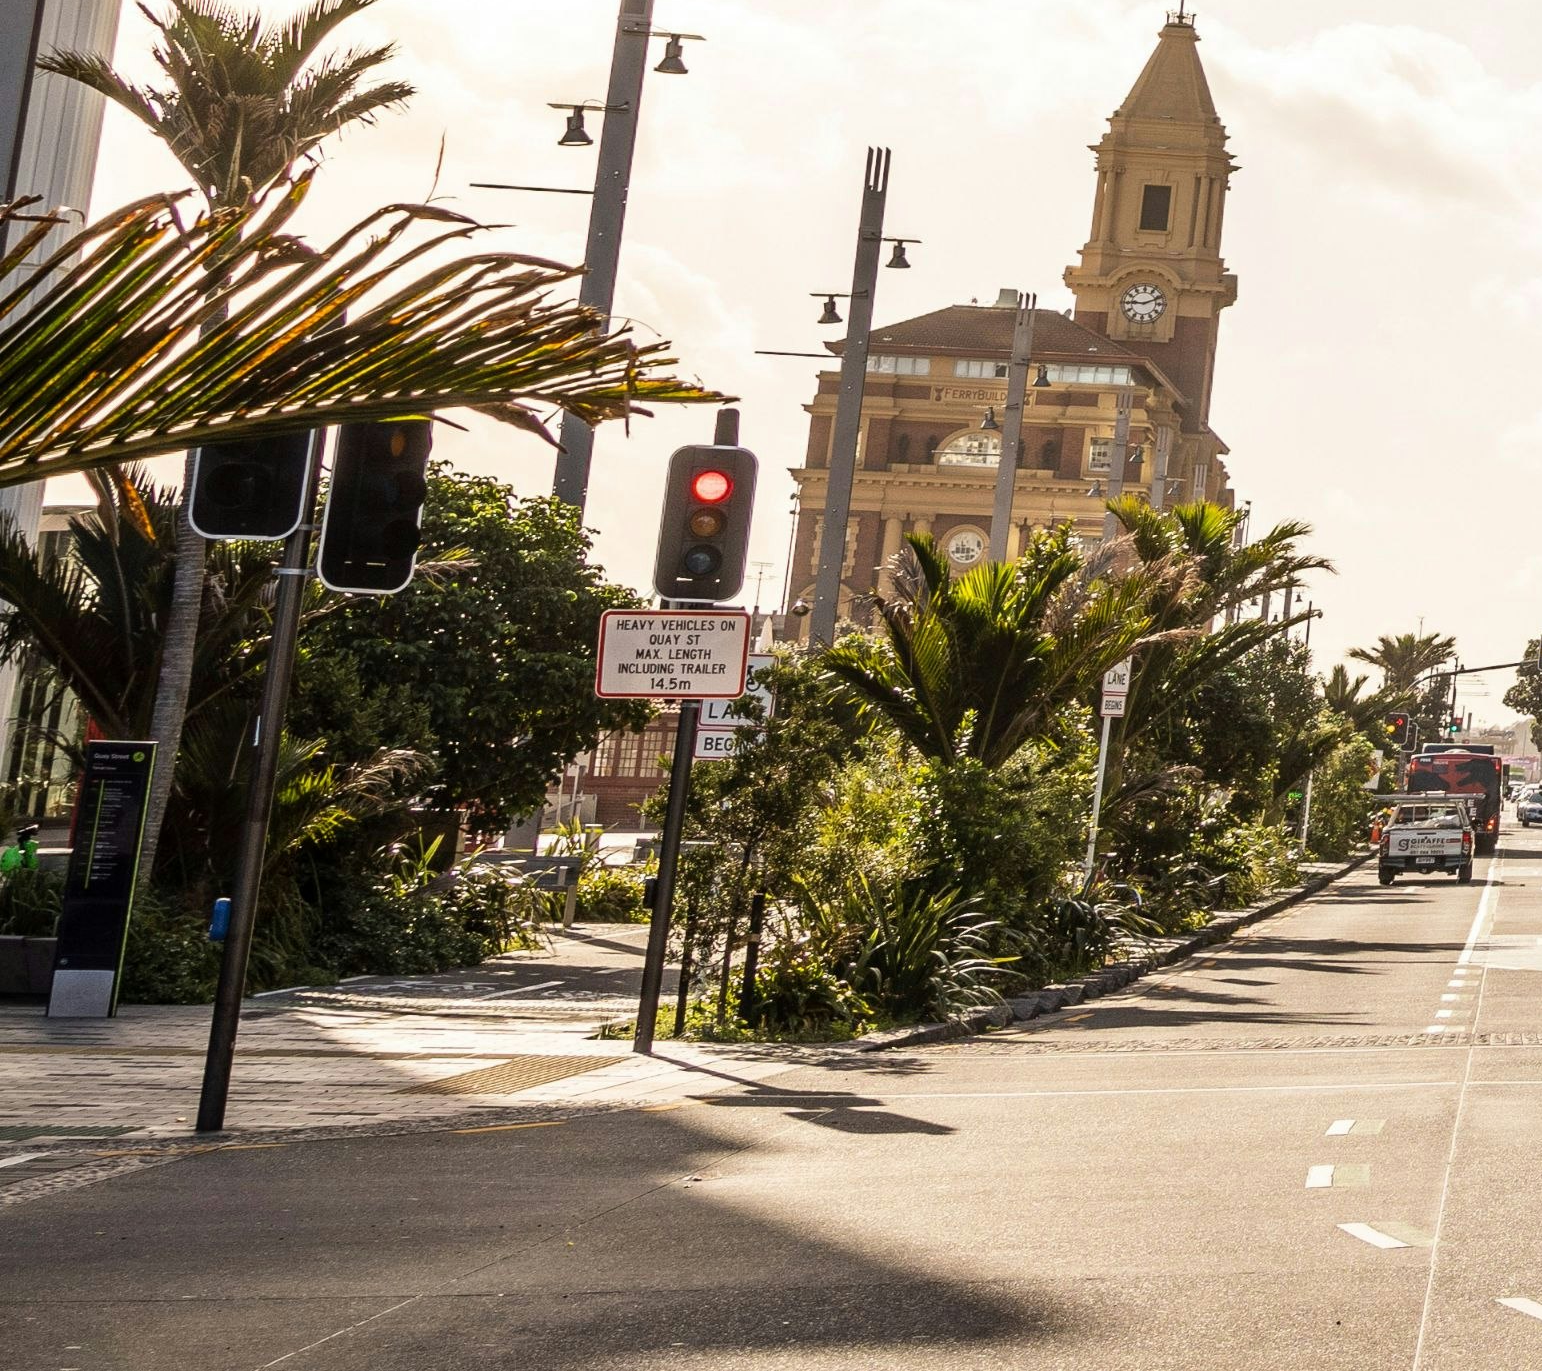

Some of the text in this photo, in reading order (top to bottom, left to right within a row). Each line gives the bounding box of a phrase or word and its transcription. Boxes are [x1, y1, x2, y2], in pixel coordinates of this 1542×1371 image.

[616, 619, 736, 631] HEAVY VEHICLES ON
[649, 634, 701, 646] QUAY ST
[635, 649, 712, 660] MAX. LENGTH
[618, 663, 727, 675] INCLUDING TRAILER
[650, 678, 691, 690] 14.5m
[1107, 672, 1127, 686] LANE
[1104, 700, 1123, 710] BEGINS
